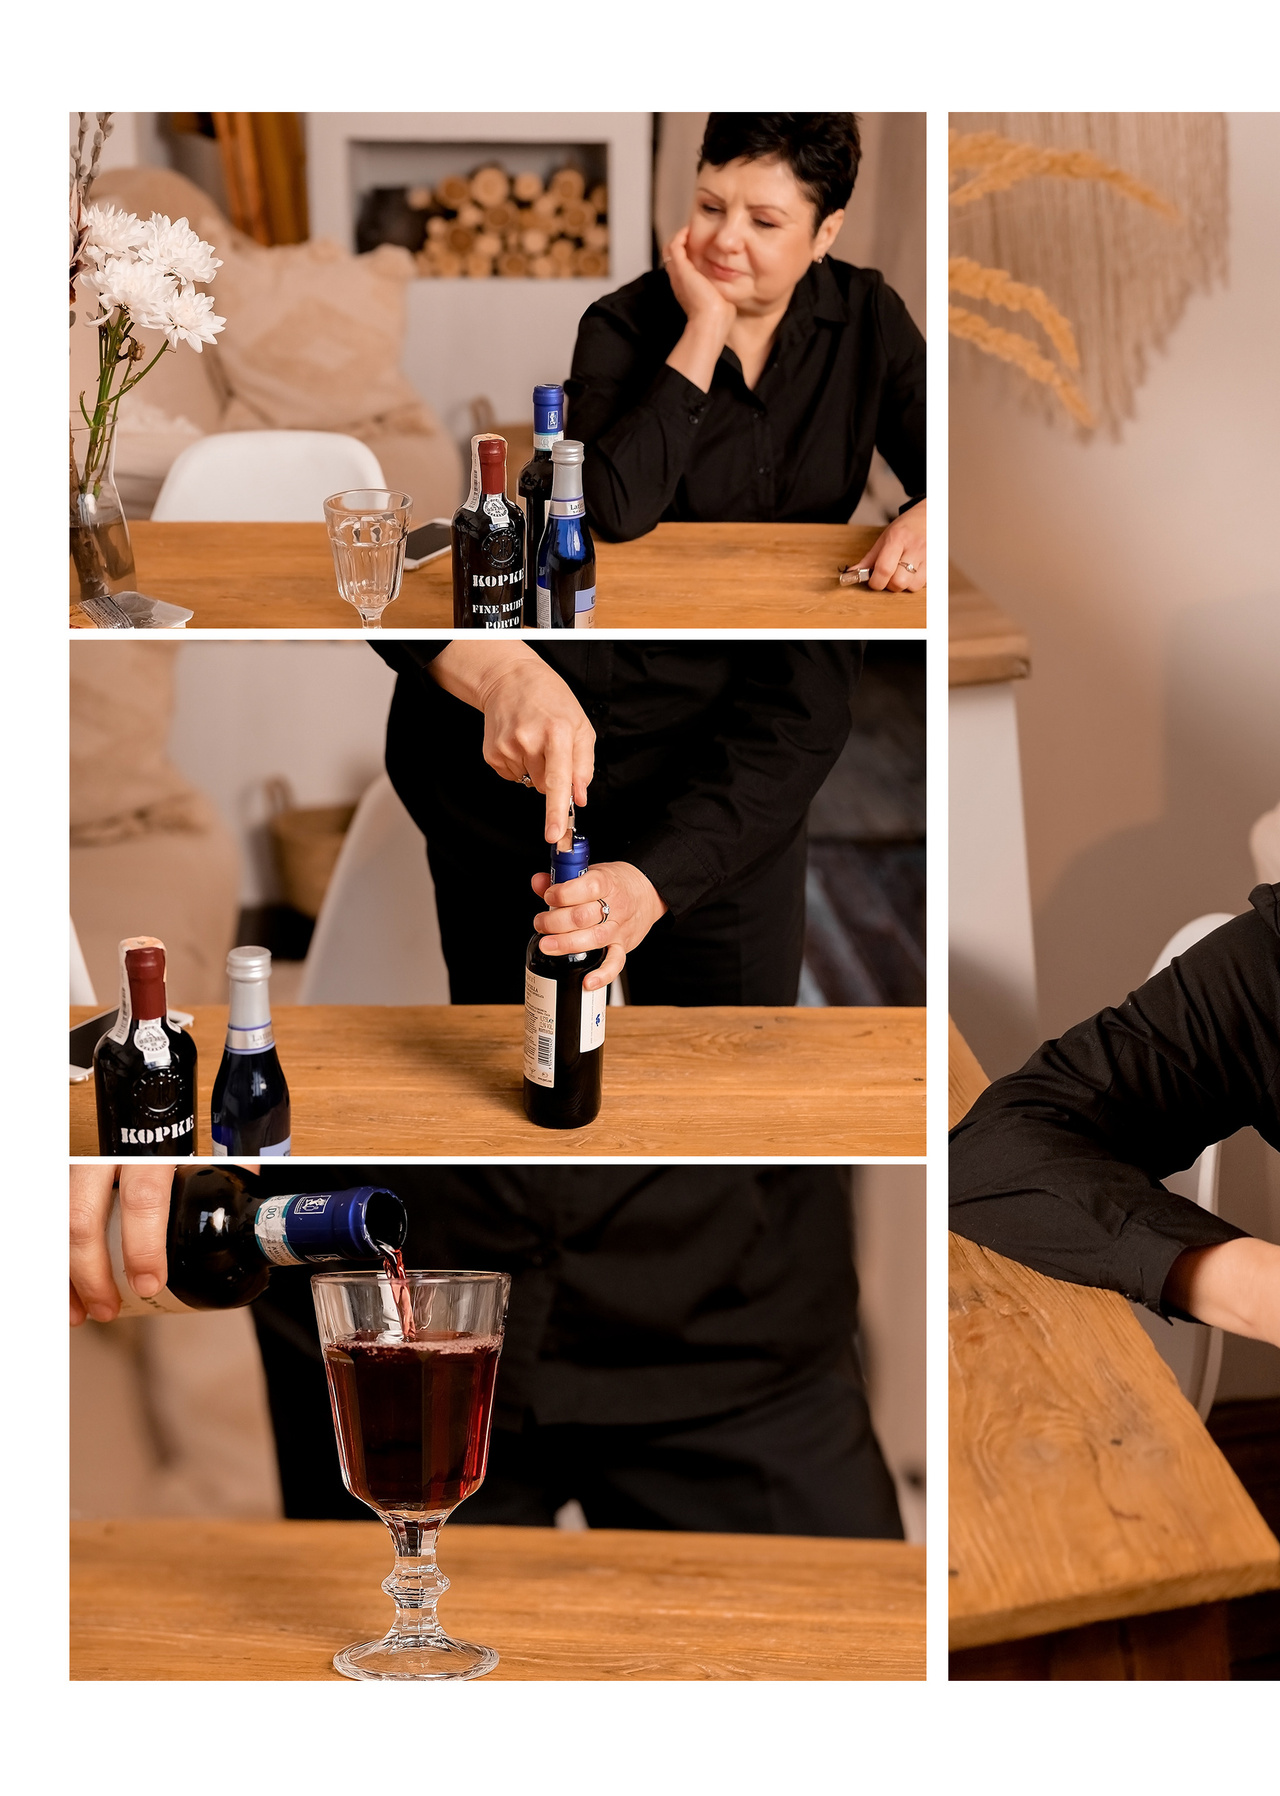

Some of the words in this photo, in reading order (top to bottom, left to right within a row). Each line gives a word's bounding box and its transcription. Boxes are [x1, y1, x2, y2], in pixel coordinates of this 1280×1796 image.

[472, 567, 525, 588] KOPKE
[472, 604, 500, 614] FINE
[501, 596, 525, 613] RUBY
[485, 615, 520, 629] PORTO
[120, 1115, 194, 1144] KOPKE
